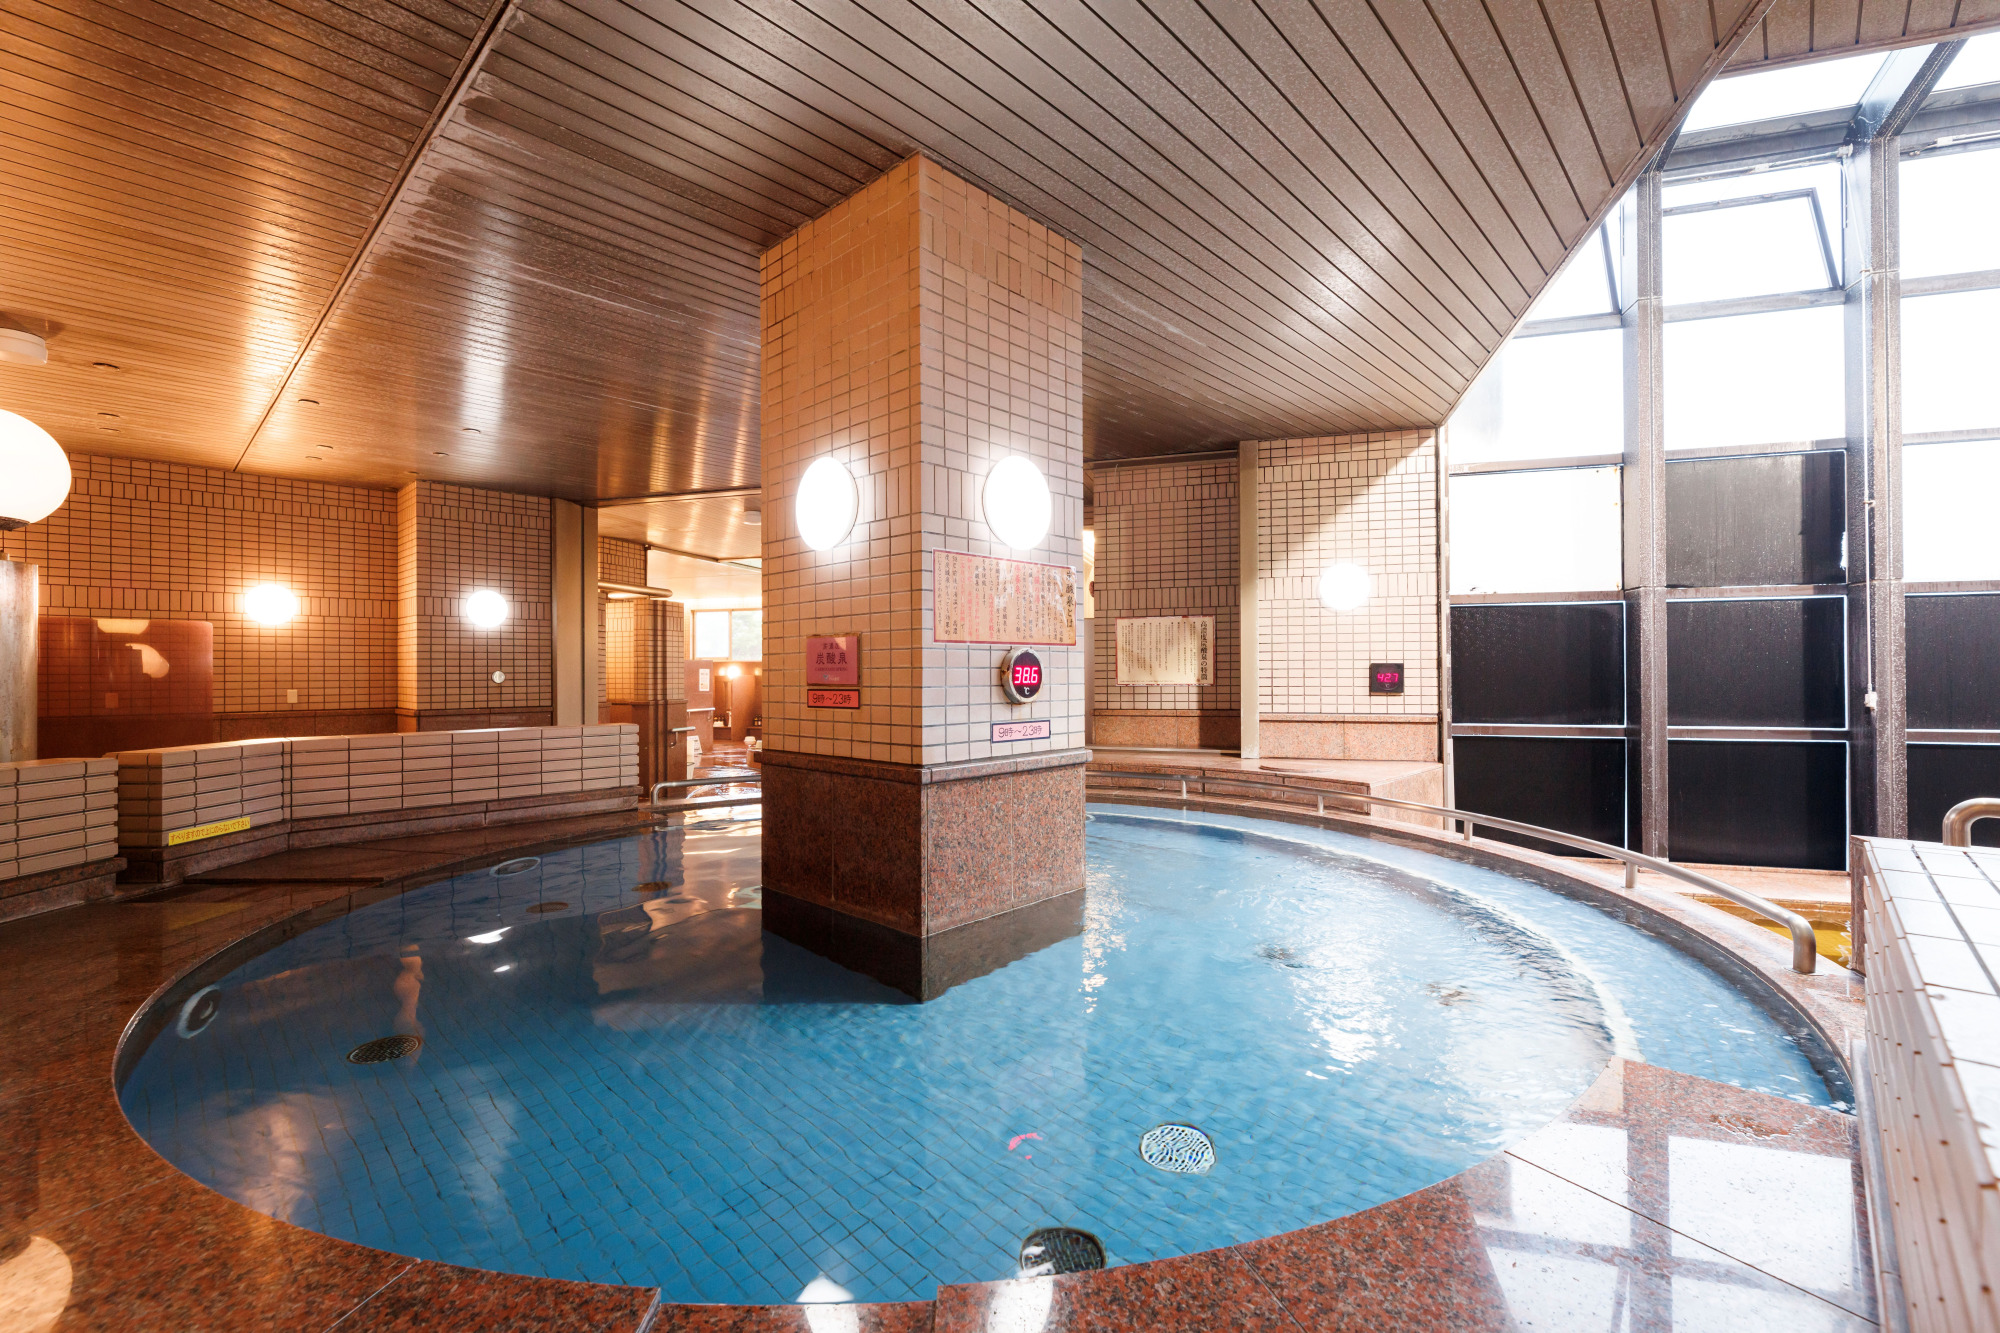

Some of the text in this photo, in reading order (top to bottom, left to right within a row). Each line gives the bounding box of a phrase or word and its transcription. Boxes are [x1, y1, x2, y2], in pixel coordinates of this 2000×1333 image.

[815, 652, 848, 665] 炭酸泉
[1014, 666, 1039, 684] 38.6
